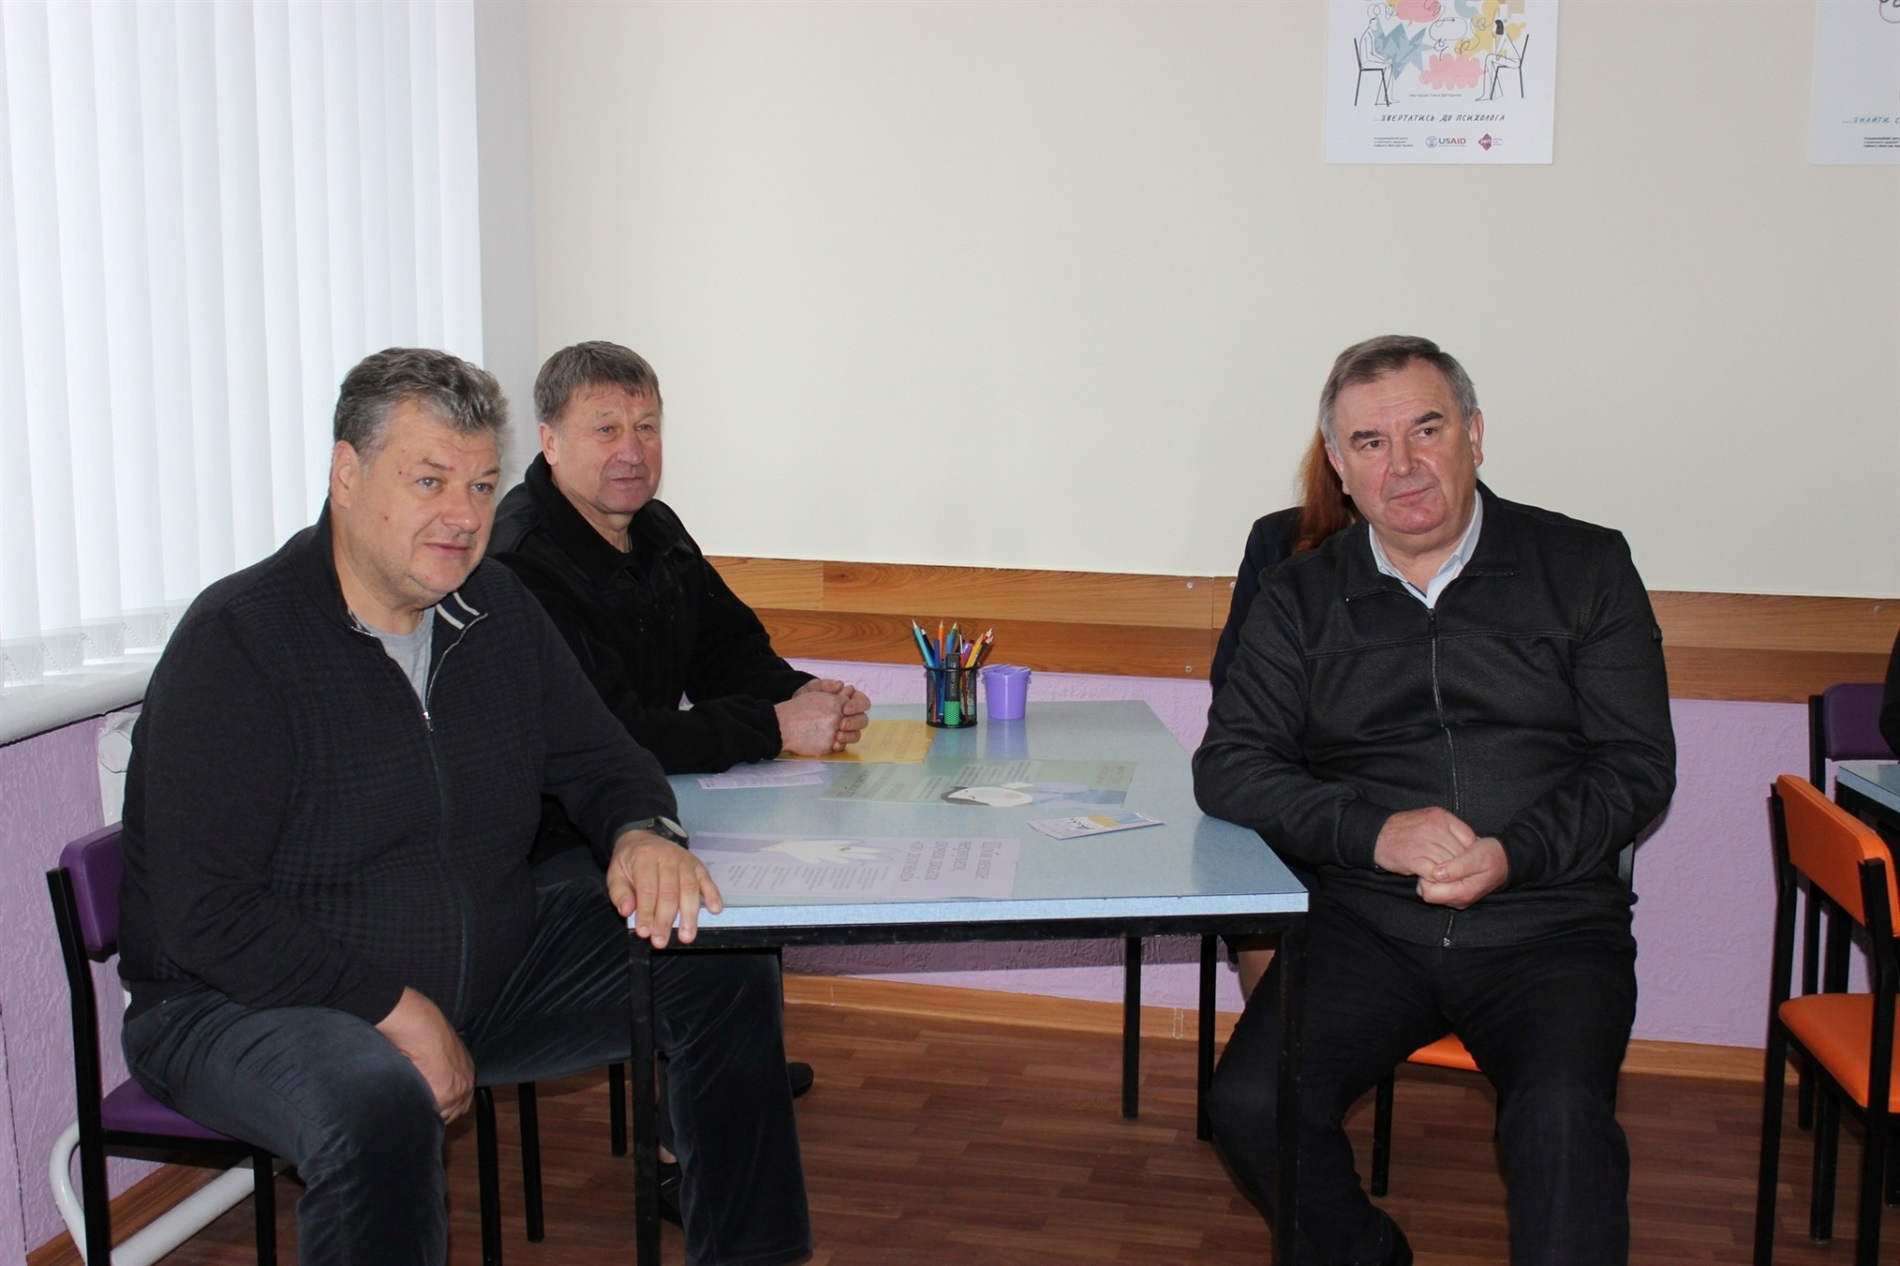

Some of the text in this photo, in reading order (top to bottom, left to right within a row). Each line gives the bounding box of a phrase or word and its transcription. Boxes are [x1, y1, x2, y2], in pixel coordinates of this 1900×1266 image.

[1439, 114, 1453, 122] ДО
[1456, 114, 1506, 122] ПСИХОЛОГА
[1438, 137, 1467, 145] USAID
